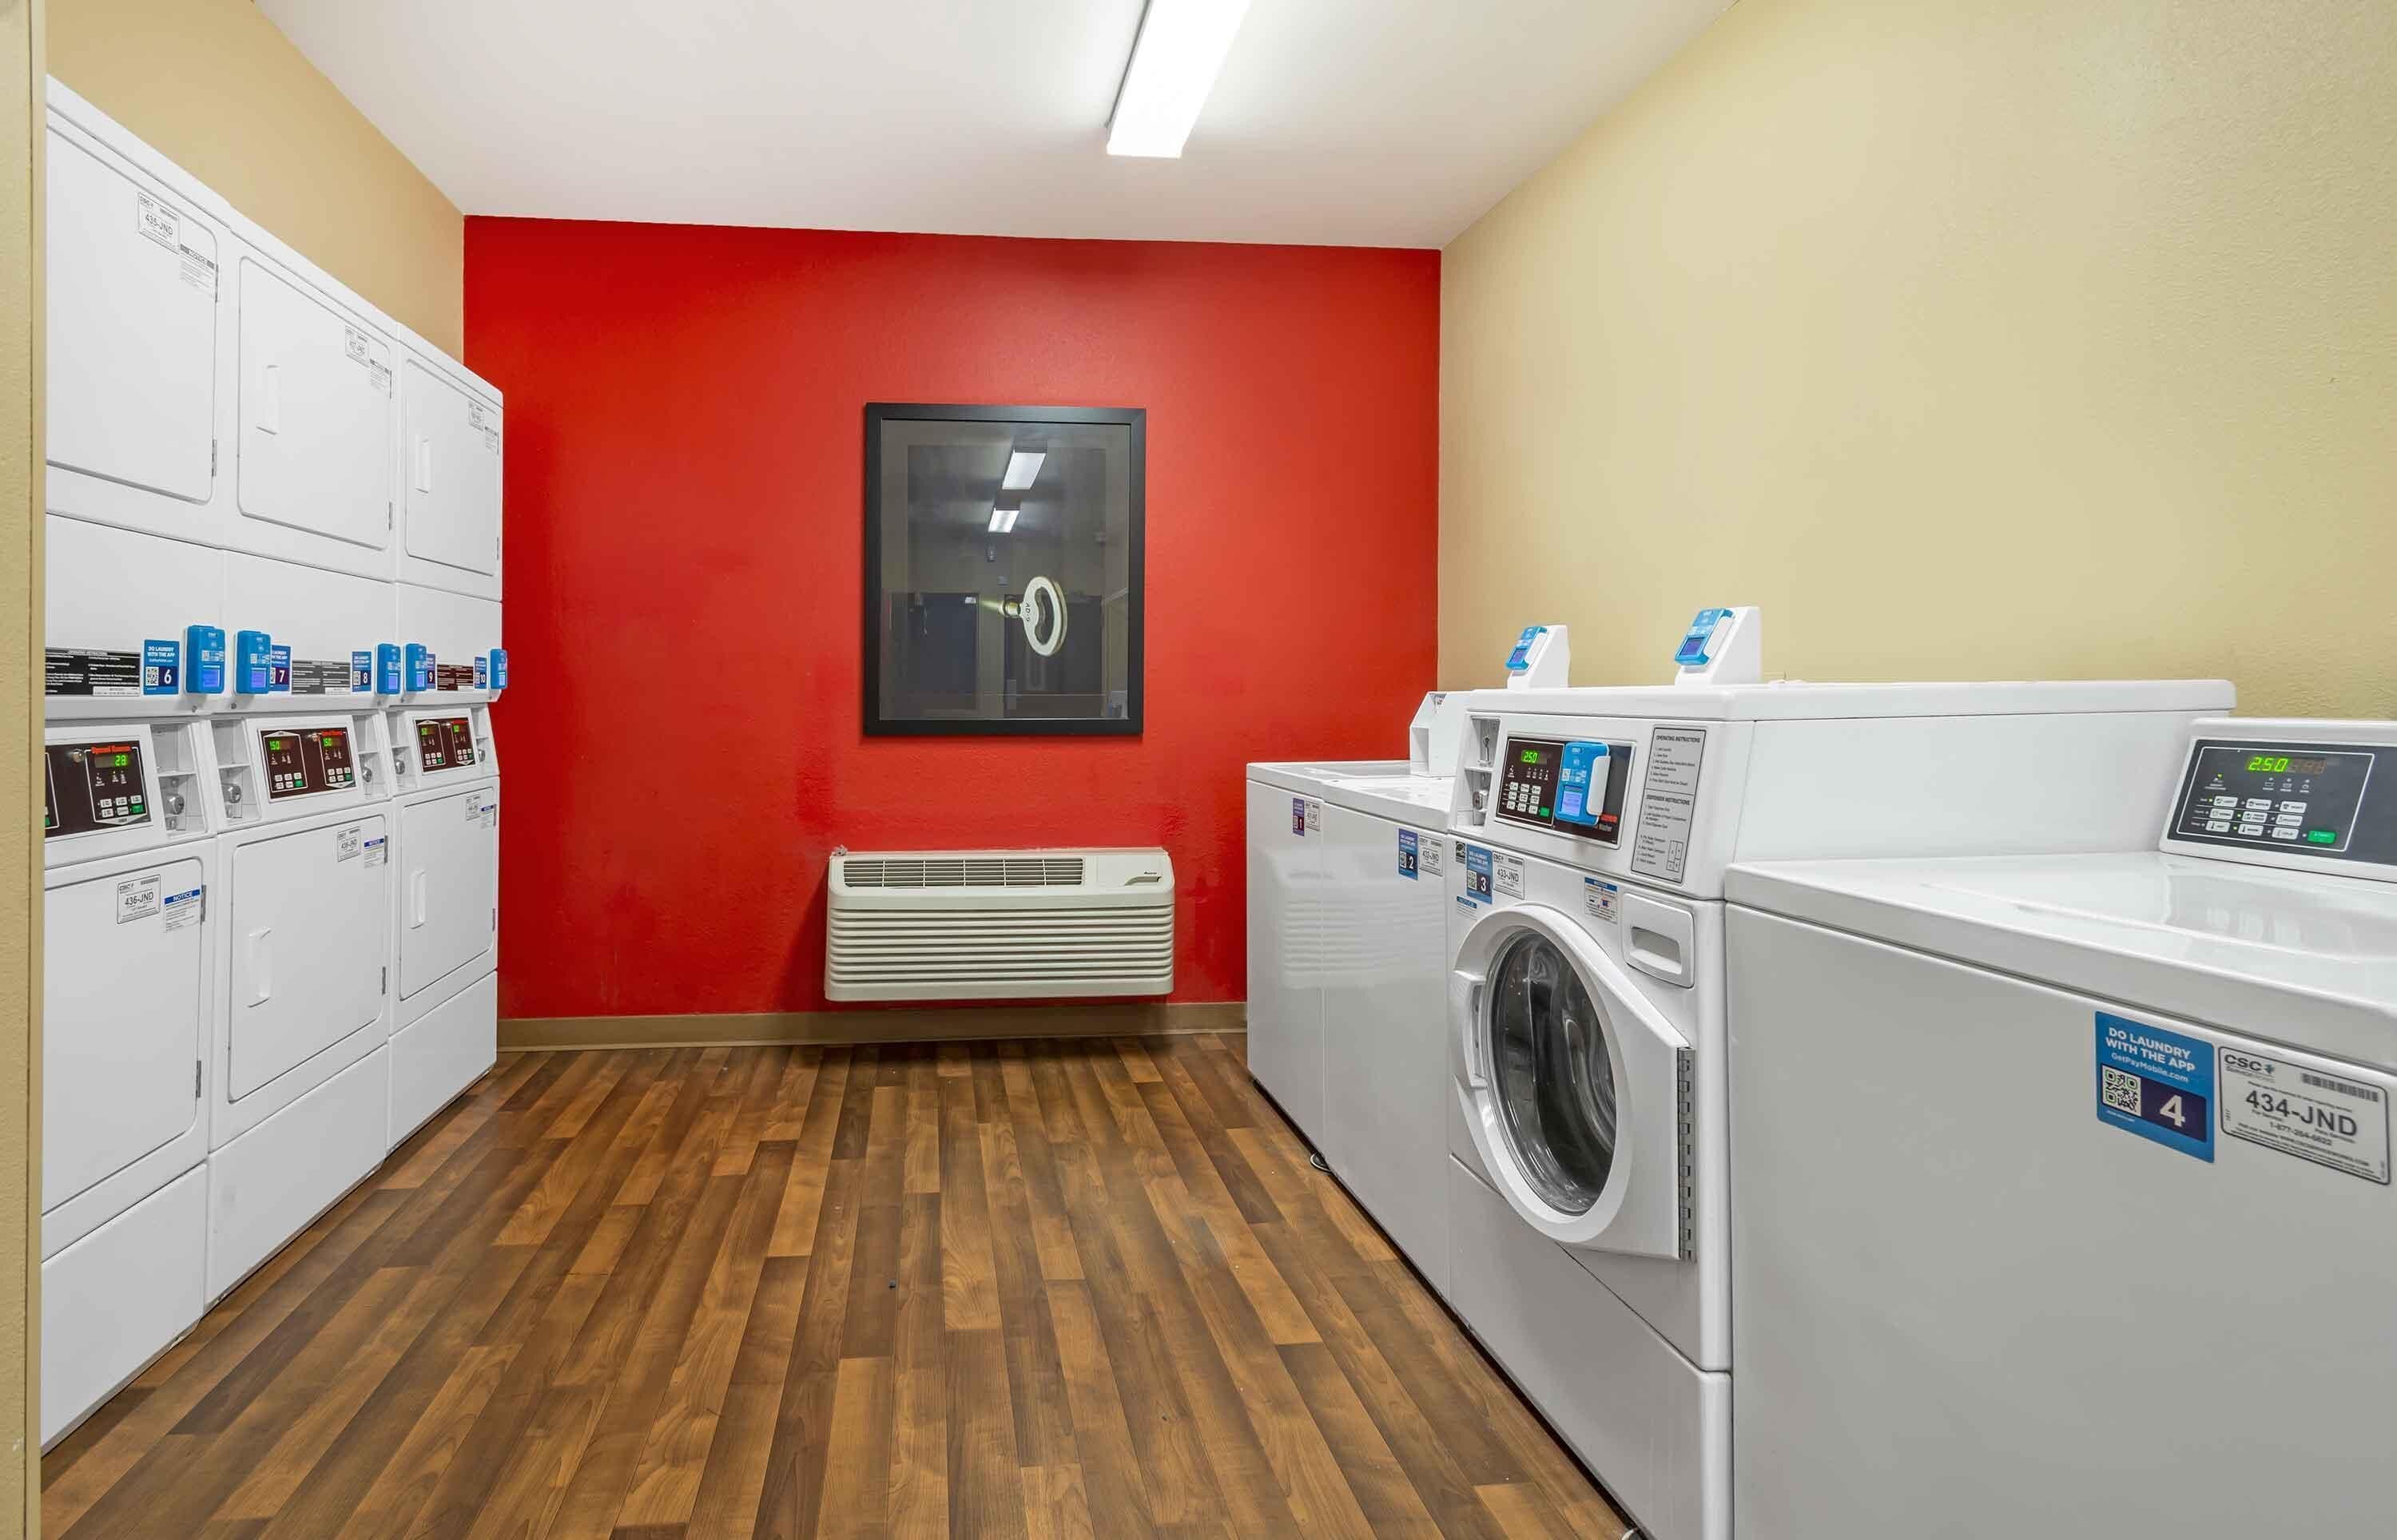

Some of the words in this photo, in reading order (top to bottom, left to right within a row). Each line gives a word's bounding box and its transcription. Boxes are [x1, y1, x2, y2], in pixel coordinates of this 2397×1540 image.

[164, 669, 172, 685] 6
[280, 669, 285, 683] 7
[363, 672, 368, 685] 8
[428, 671, 433, 682] 9
[1409, 855, 1413, 870] 2
[1481, 876, 1487, 892] 3
[2109, 1027, 2126, 1039] DO
[2129, 1033, 2192, 1060] LAUNDRY
[2105, 1037, 2138, 1055] WITH
[2141, 1047, 2166, 1064] THE
[2168, 1058, 2196, 1072] APP
[2224, 1054, 2263, 1072] CSC
[2111, 1052, 2189, 1083] GetPayMobile.com
[2160, 1094, 2185, 1127] 4
[2245, 1090, 2358, 1137] 434-JND
